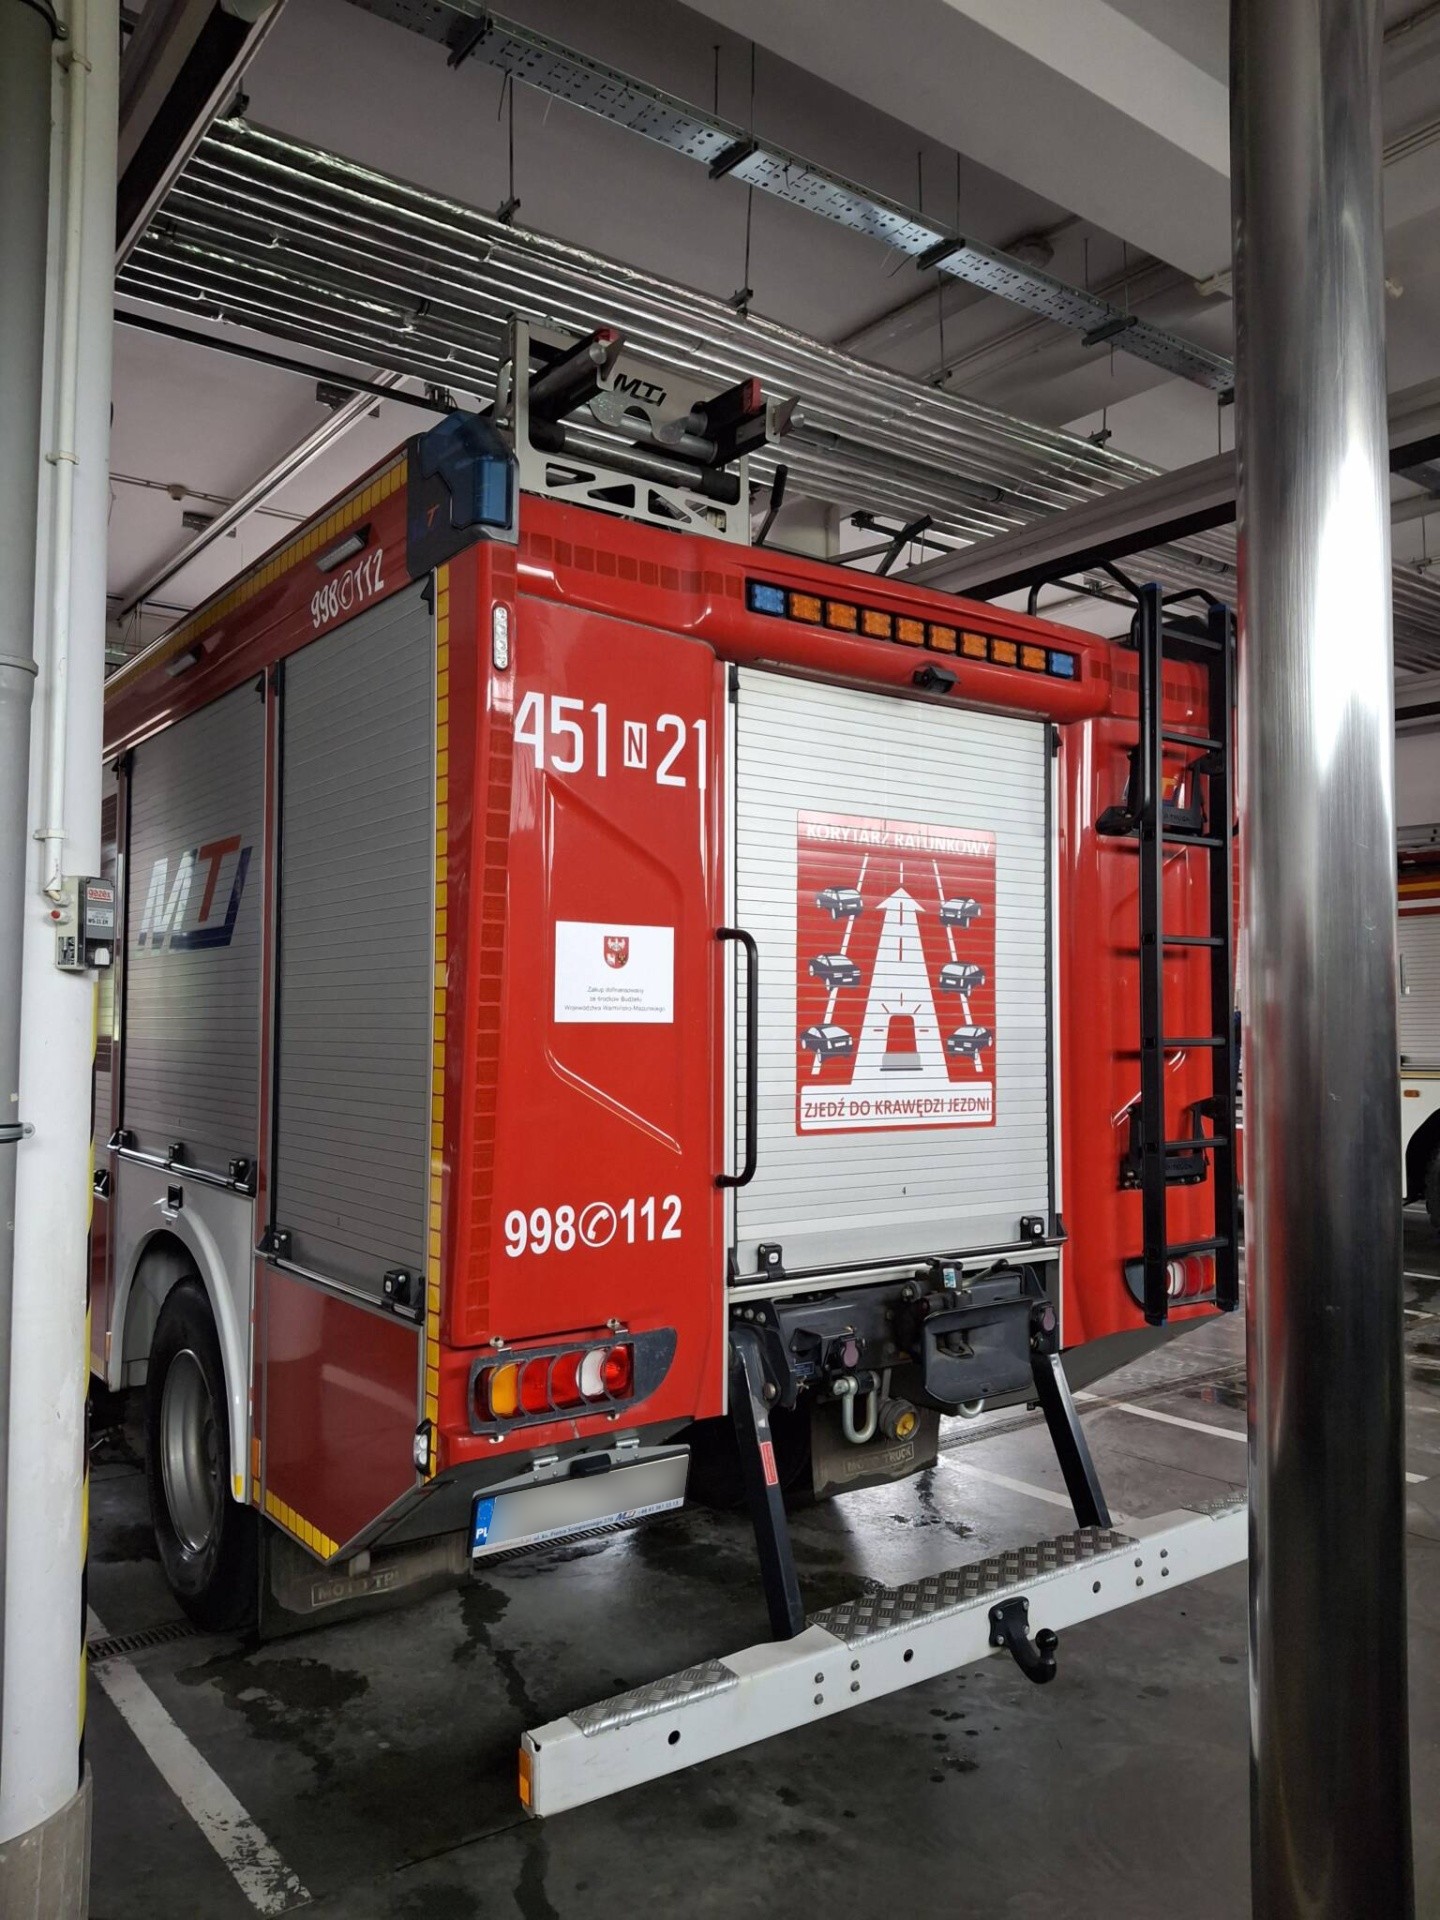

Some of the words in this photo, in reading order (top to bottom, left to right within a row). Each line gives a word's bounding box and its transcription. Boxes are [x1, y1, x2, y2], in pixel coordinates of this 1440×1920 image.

[311, 579, 339, 629] 998
[354, 548, 385, 601] 112
[514, 691, 607, 777] 451
[625, 721, 646, 767] N
[656, 713, 706, 789] 21
[805, 1097, 845, 1118] ZJEDŹ
[850, 1101, 870, 1116] DO
[875, 1098, 944, 1117] KRAWĘDZI
[948, 1097, 990, 1112] JEZDNI
[505, 1205, 576, 1258] 998
[620, 1194, 682, 1244] 112
